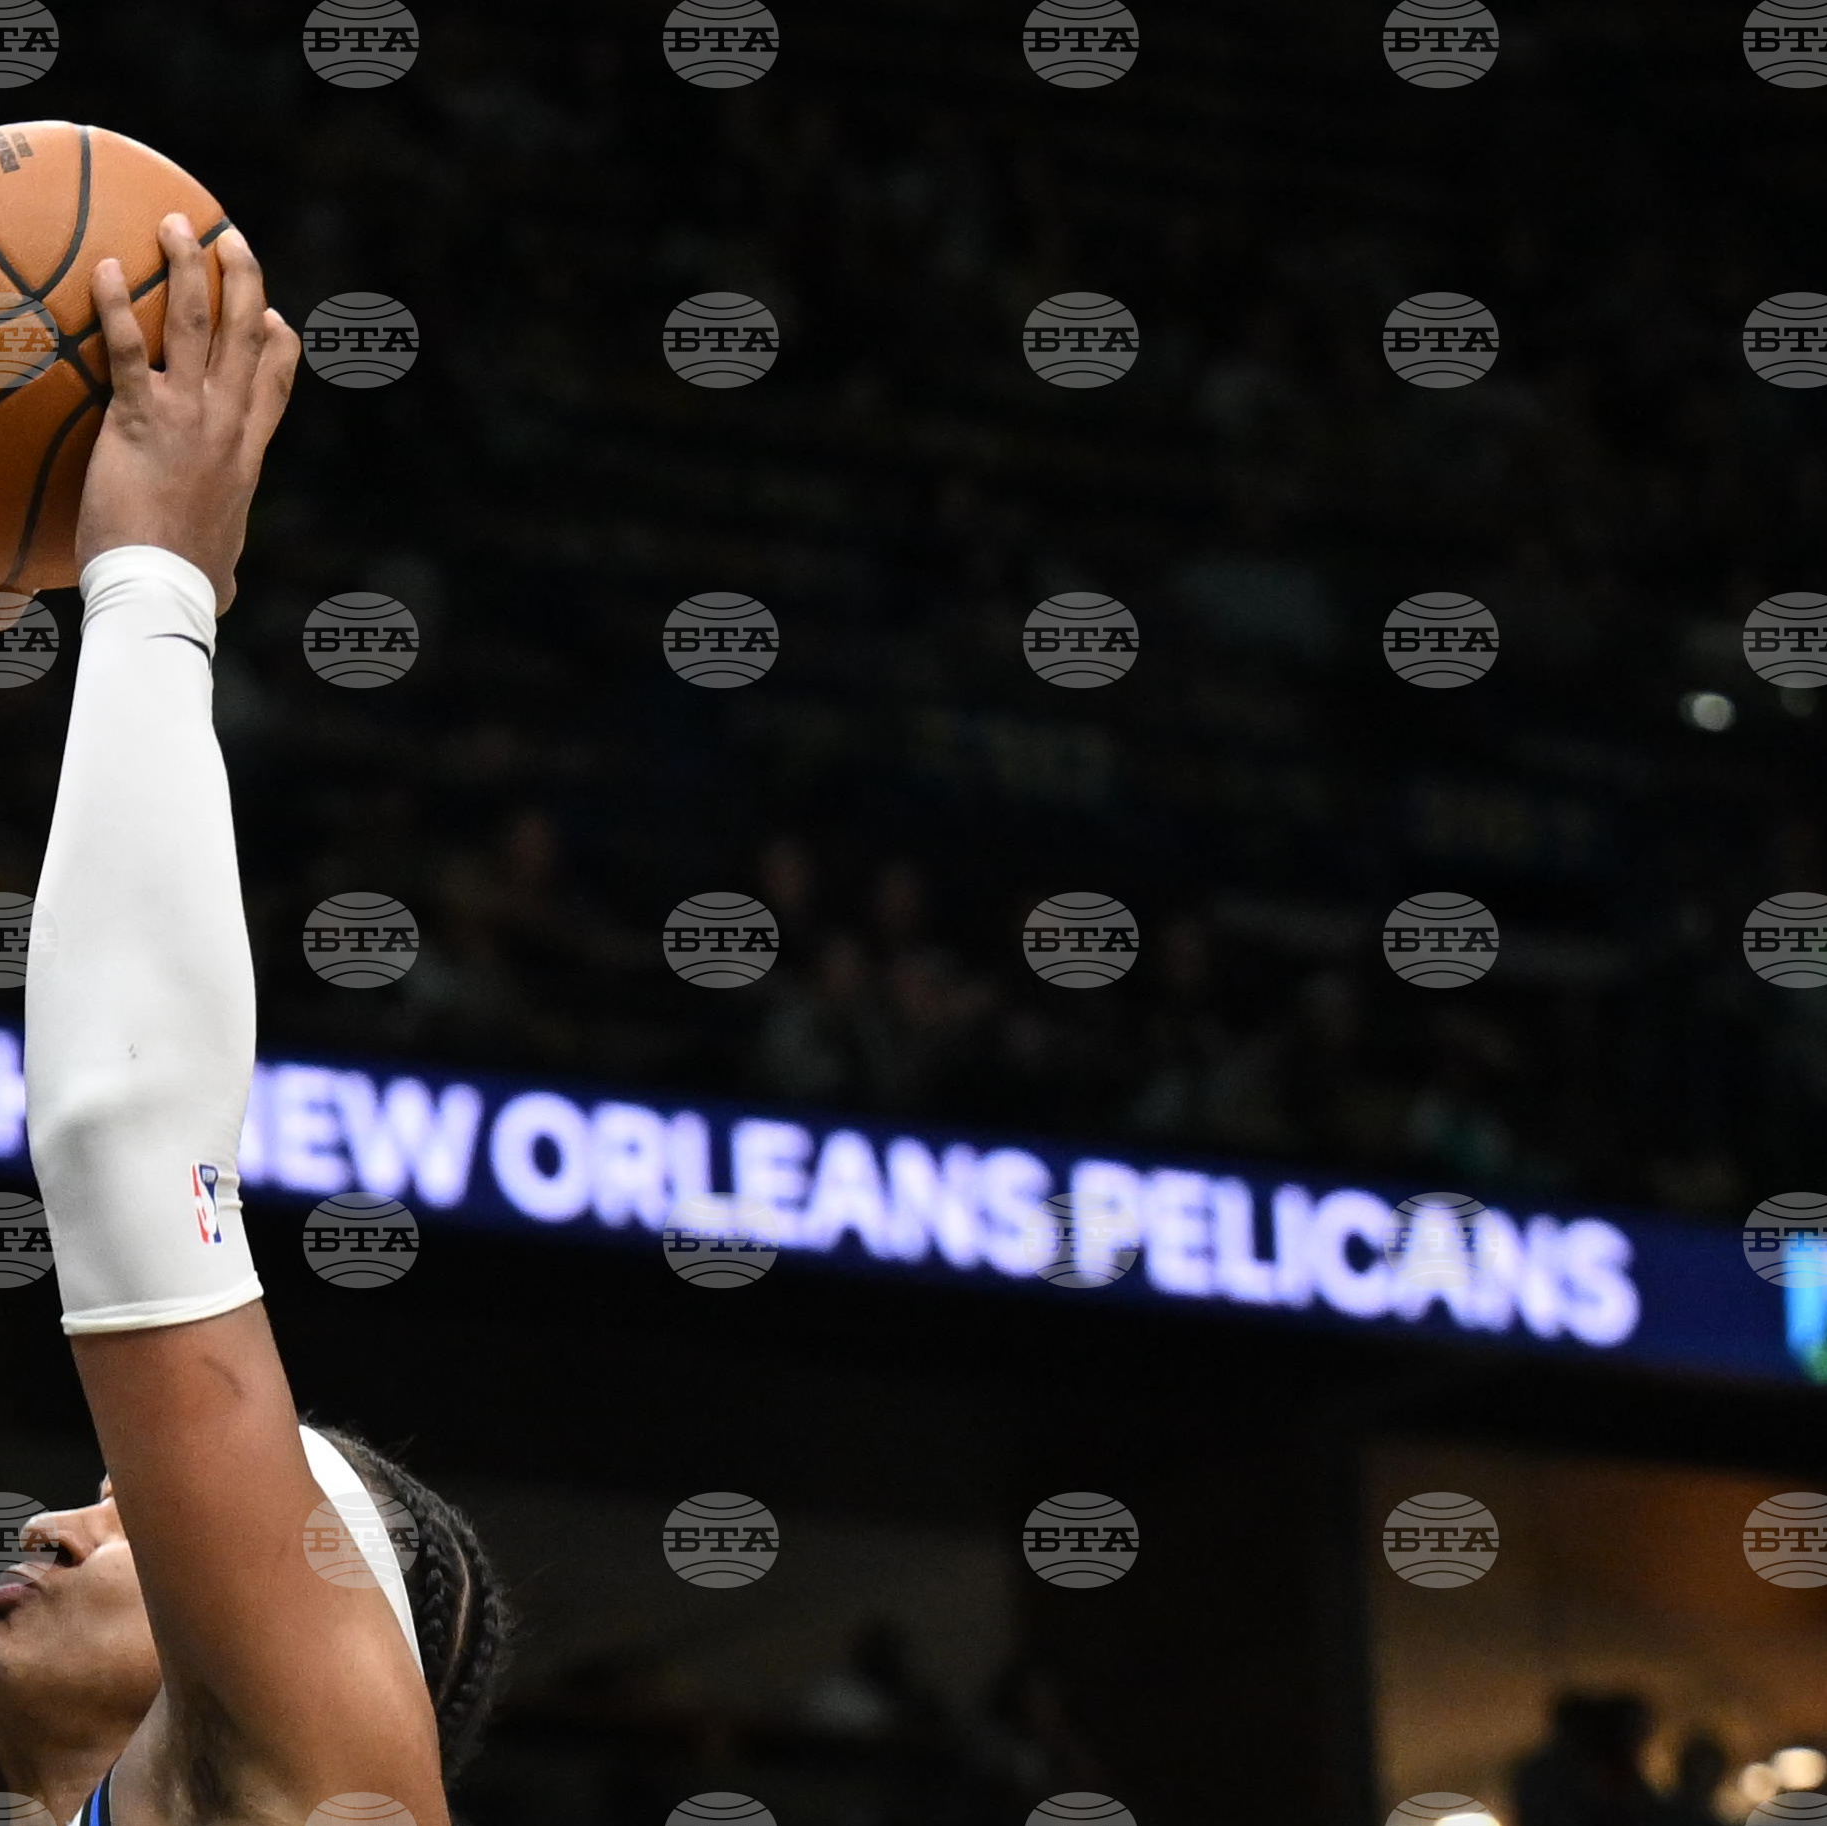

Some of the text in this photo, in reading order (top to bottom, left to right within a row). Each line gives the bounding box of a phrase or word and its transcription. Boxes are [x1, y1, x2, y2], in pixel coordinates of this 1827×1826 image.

[240, 1063, 482, 1207] EW
[490, 1092, 1056, 1278] ORLEANS
[1068, 1160, 1640, 1345] PELICANS
